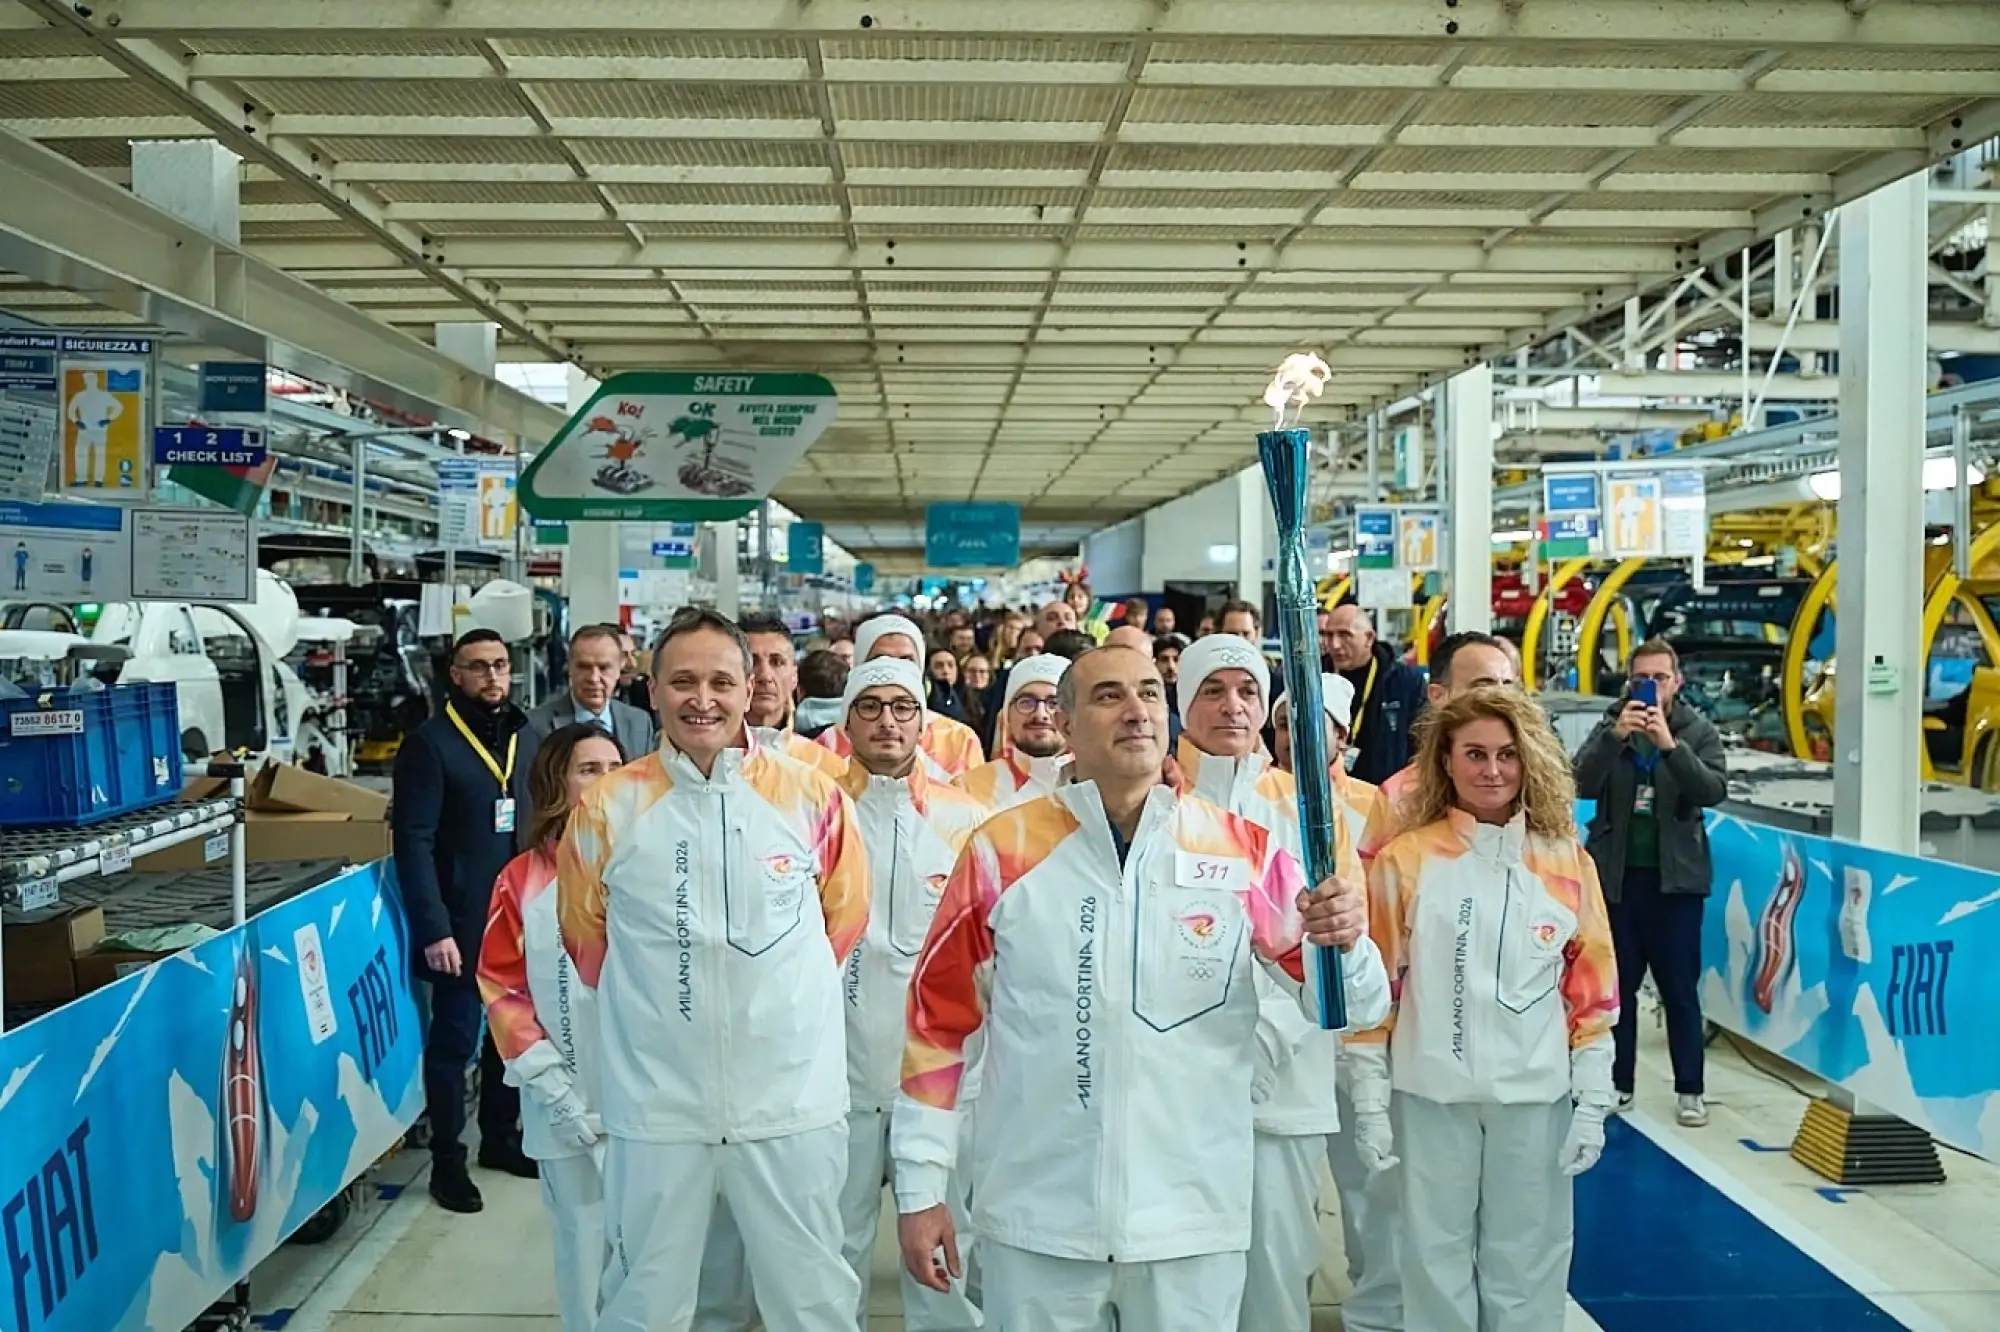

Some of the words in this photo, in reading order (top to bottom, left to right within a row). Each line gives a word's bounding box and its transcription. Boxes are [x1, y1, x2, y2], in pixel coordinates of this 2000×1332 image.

[65, 338, 138, 352] SICUREZZA
[693, 376, 755, 393] SAFETY
[166, 450, 217, 462] CHECK
[221, 451, 254, 463] LIST
[173, 432, 183, 444] 1
[206, 432, 218, 445] 2
[806, 537, 820, 559] 3
[676, 840, 689, 874] 2026
[676, 879, 692, 948] CORTINA
[1080, 896, 1096, 933] 2026
[1459, 897, 1473, 925] 2026
[678, 952, 692, 1022] MILANO
[848, 948, 862, 1008] MILANO
[1076, 940, 1093, 1024] CORTINA
[1453, 930, 1468, 991] CORTINA
[1886, 939, 1955, 1036] FIAT
[347, 943, 399, 1085] FIAT
[1451, 994, 1465, 1061] MILANO
[560, 1016, 577, 1075] MILANO
[1076, 1028, 1092, 1110] MILANO
[2, 1116, 99, 1332] FIAT
